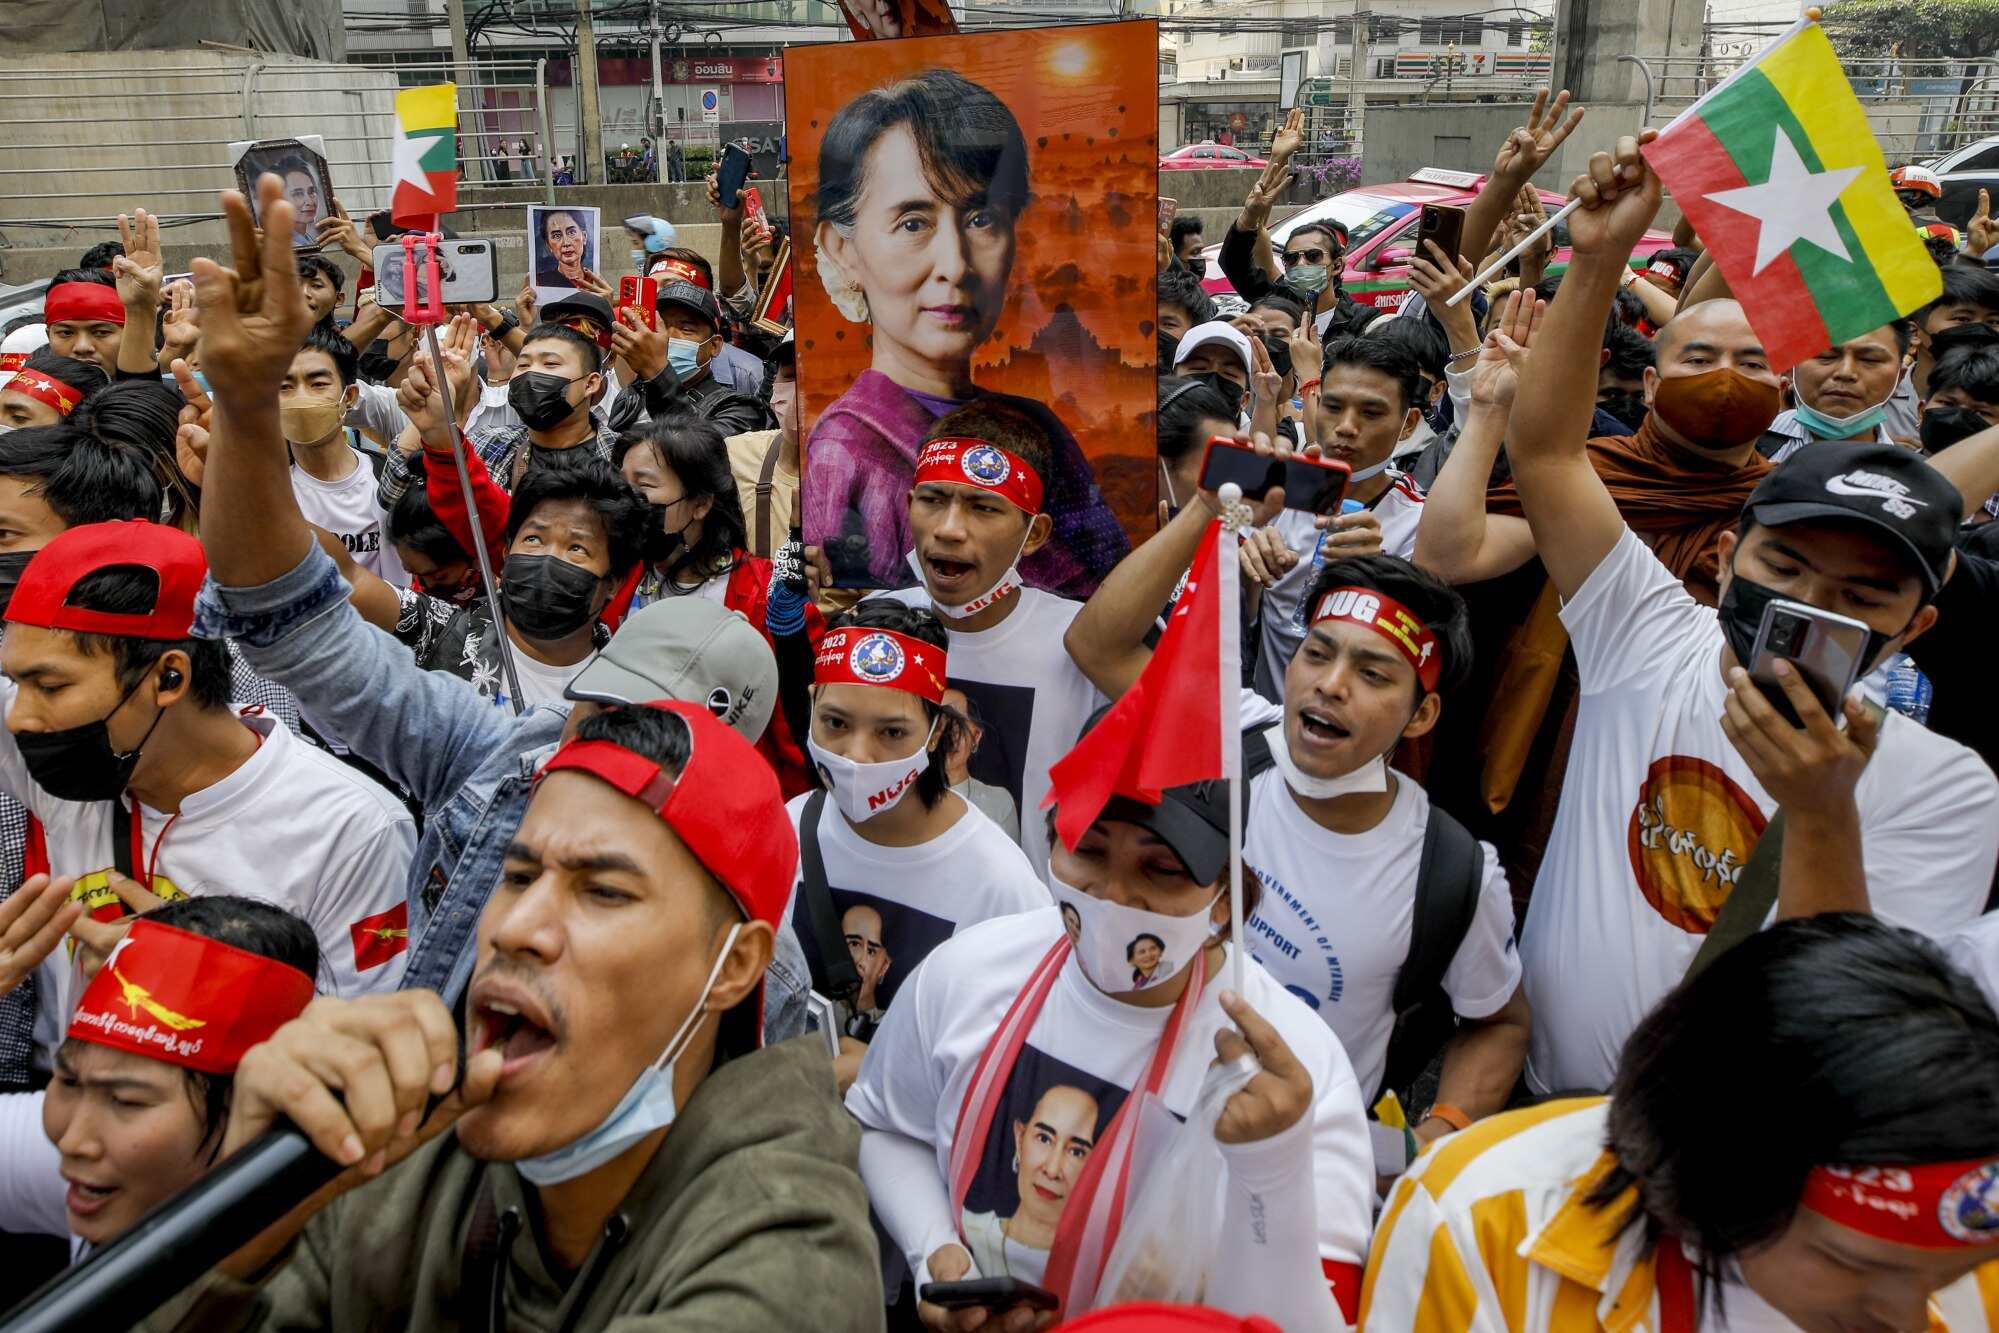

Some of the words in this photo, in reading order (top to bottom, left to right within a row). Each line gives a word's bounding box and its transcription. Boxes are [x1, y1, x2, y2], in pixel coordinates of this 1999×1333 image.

[694, 63, 733, 75] ออมสิน
[927, 441, 957, 453] 2023
[1317, 590, 1381, 624] NUG
[821, 634, 847, 650] 2023
[868, 768, 918, 810] NUG
[1248, 913, 1302, 960] UPPORT
[1316, 936, 1333, 951] OF
